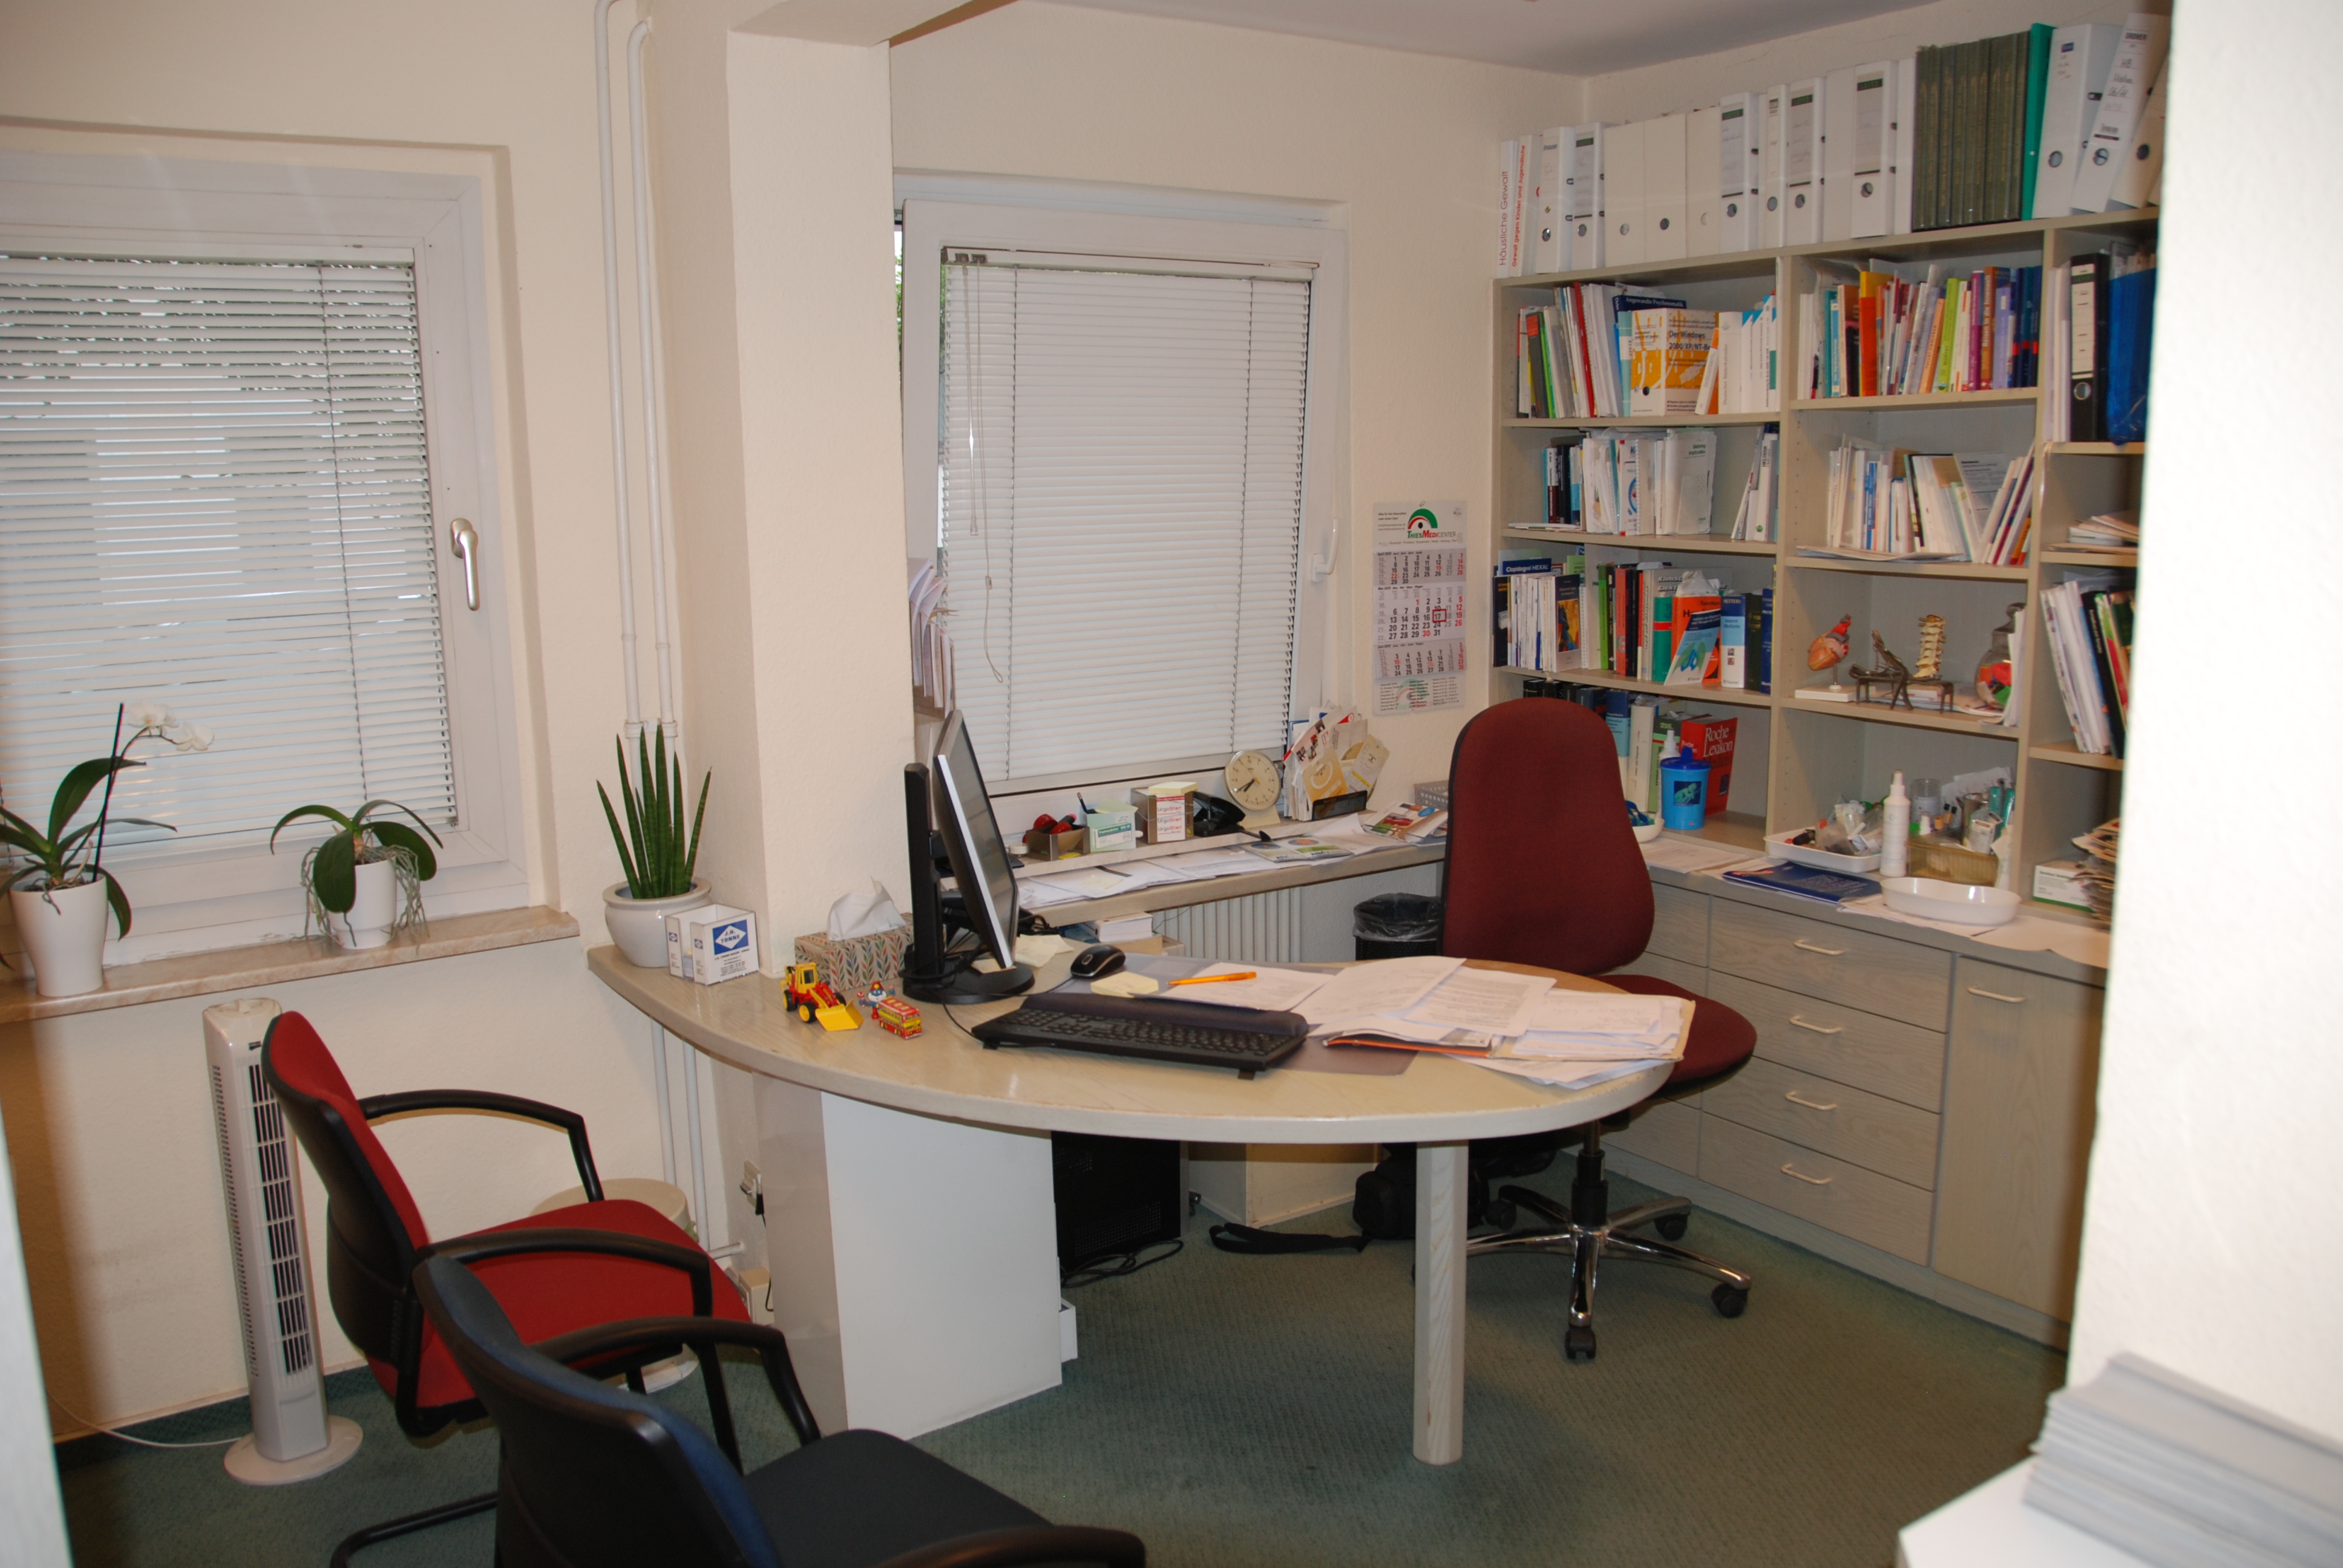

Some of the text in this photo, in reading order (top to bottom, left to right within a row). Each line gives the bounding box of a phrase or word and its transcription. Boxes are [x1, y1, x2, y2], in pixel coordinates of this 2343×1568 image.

[1499, 171, 1509, 266] Häusliche Gewalt
[1669, 342, 1711, 351] 2000/XP/NT-Be
[1705, 725, 1729, 743] Roche
[1703, 739, 1733, 757] Lexikon
[720, 934, 741, 944] TONNE
